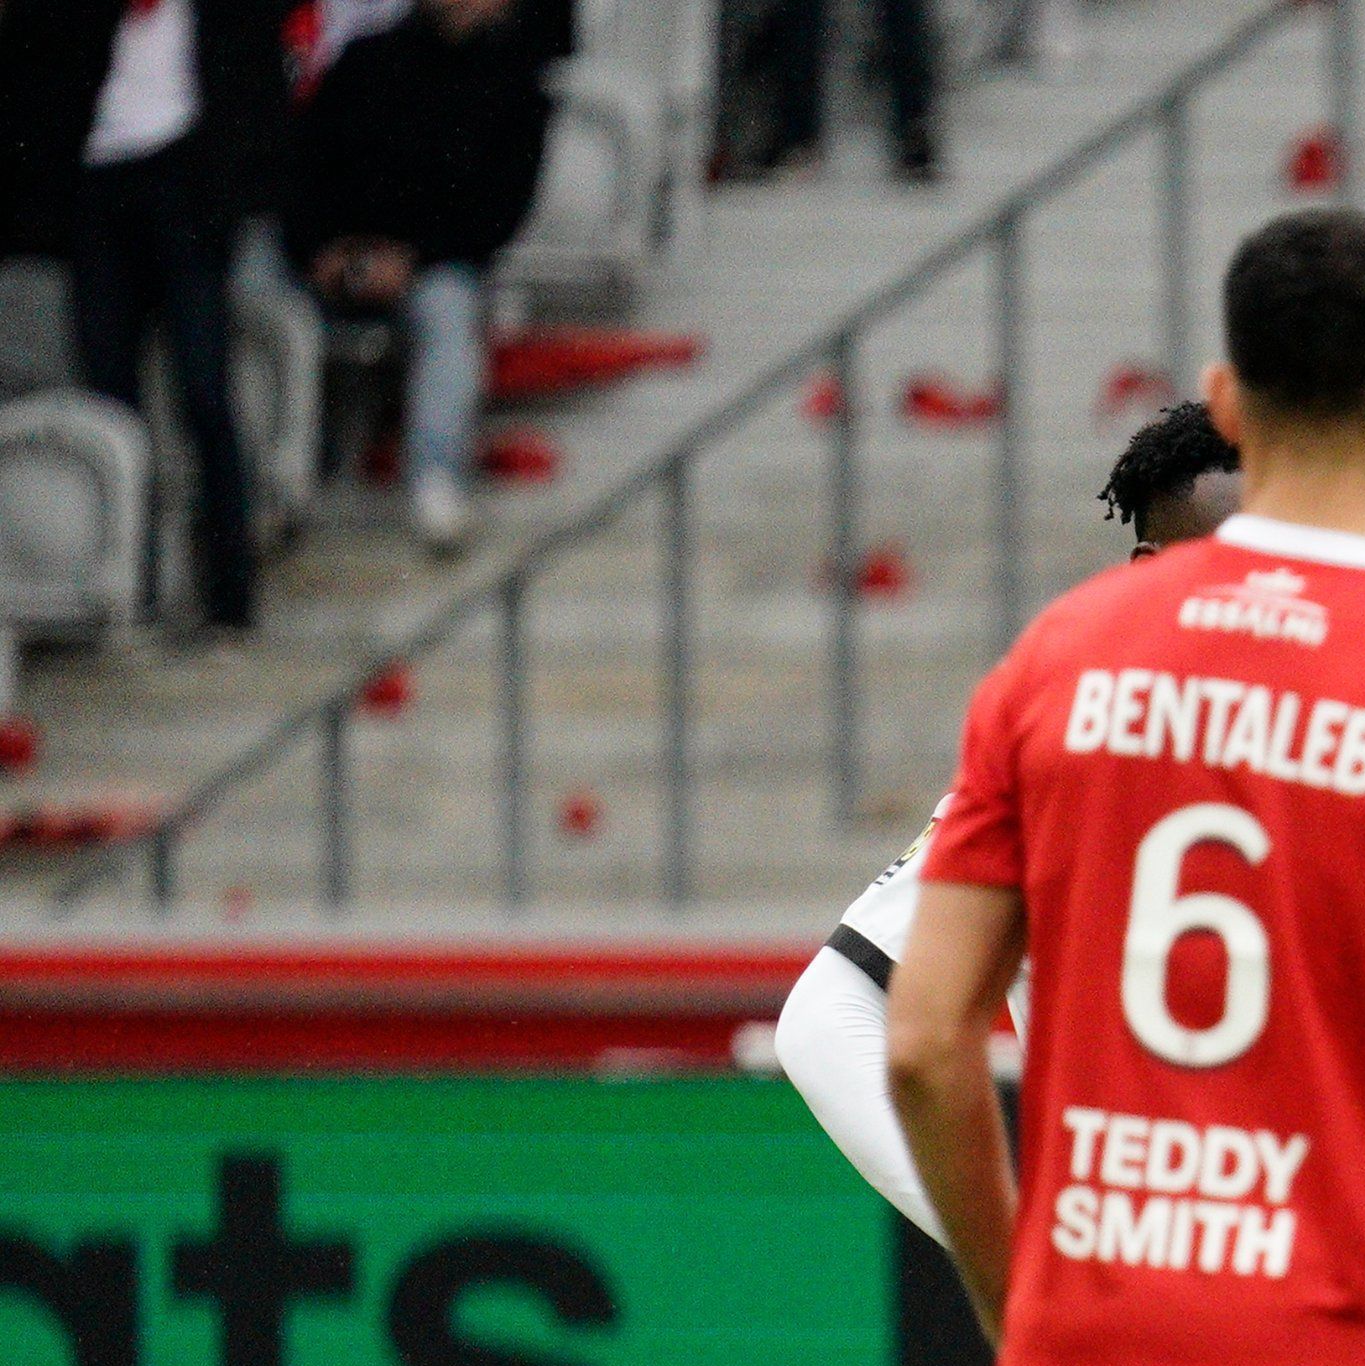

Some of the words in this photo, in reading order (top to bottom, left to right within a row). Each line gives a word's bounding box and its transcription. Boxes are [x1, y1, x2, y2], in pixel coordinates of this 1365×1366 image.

[1121, 803, 1272, 1069] 6
[1063, 1108, 1309, 1204] TEDDY
[1051, 1184, 1299, 1279] SMITH
